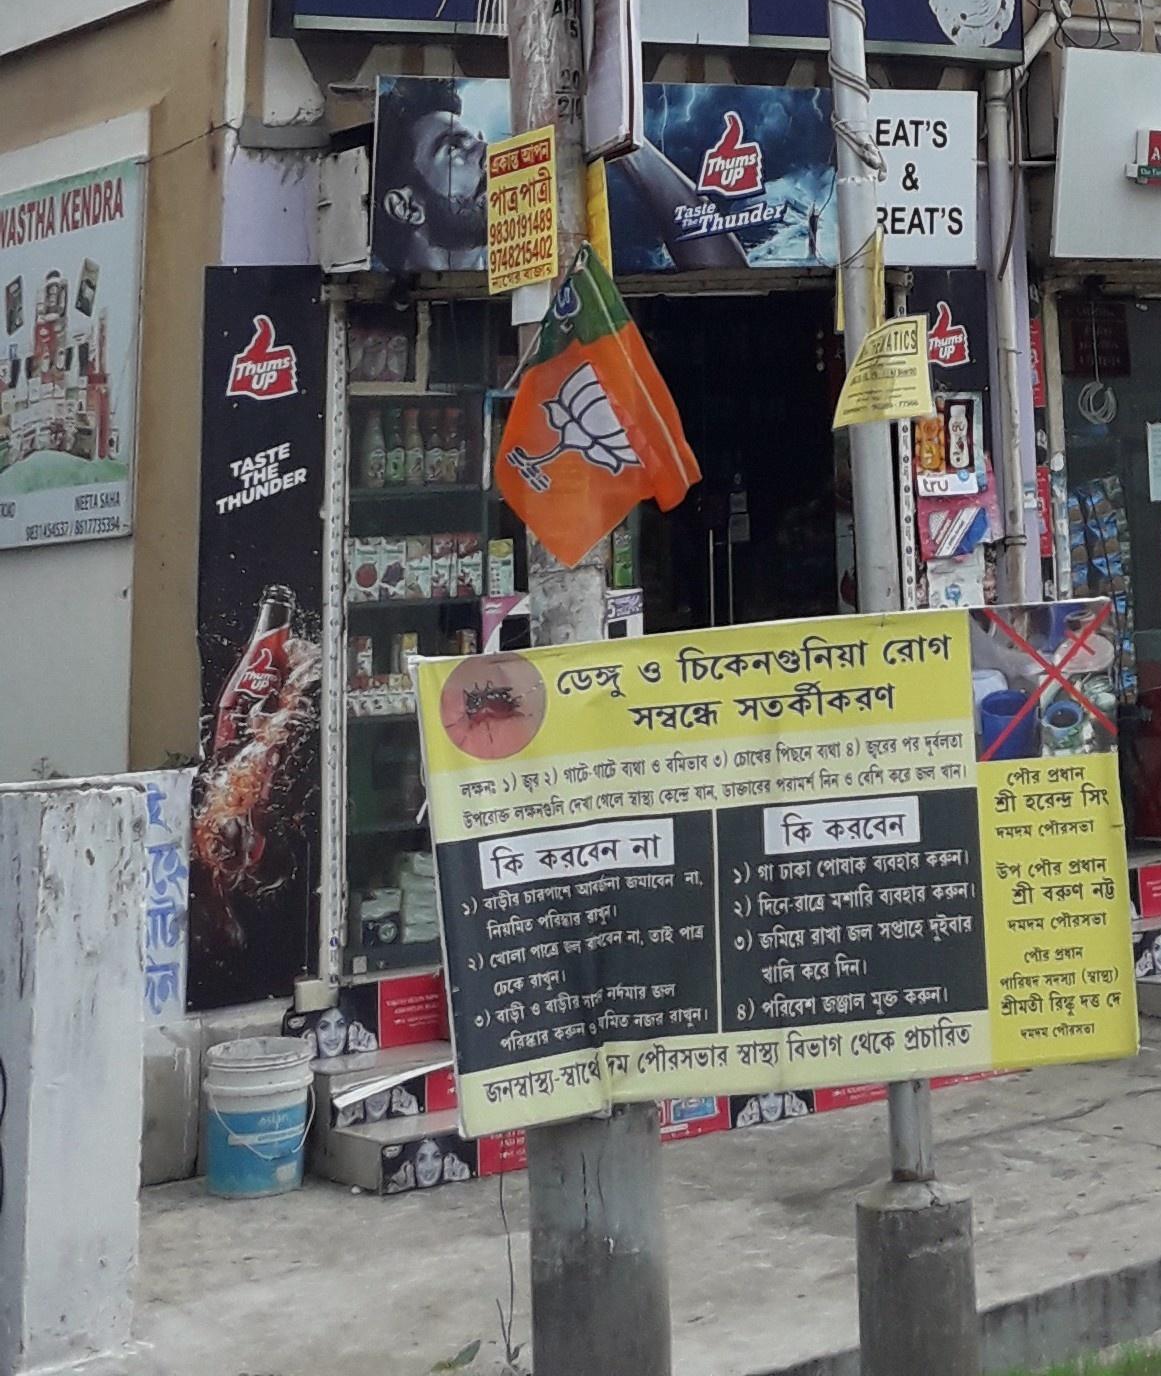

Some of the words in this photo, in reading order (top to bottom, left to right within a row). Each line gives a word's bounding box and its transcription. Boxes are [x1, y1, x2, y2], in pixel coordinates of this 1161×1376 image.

[876, 119, 948, 148] EAT'S
[707, 153, 757, 176] Thums
[720, 167, 744, 187] UP
[902, 162, 919, 191] &
[60, 176, 124, 233] KENDRA
[674, 203, 716, 221] Taste
[699, 203, 785, 233] Thunder
[490, 208, 552, 247] 9830191489
[876, 207, 963, 235] REAT'S
[490, 235, 552, 273] 9748215402
[940, 346, 956, 359] UP
[236, 356, 291, 380] Thums
[251, 371, 278, 390] UP
[230, 442, 291, 478] TASTE
[240, 462, 279, 489] THE
[923, 478, 948, 493] tru
[215, 467, 308, 515] THUNDER
[557, 664, 626, 698] ডেঙ্গু
[638, 661, 662, 683] ও
[883, 633, 952, 666] রোগ
[733, 681, 895, 722] সতর্কীকরণ
[902, 737, 920, 754] পর
[1006, 767, 1041, 787] পৌর
[1048, 767, 1086, 783] প্রধান
[994, 790, 1016, 812] শ্রী
[1023, 790, 1074, 810] হরেন্দ্র
[1080, 782, 1109, 808] সিং
[780, 812, 813, 846] কি
[823, 813, 906, 841] করবেন
[995, 824, 1032, 839] দমদম
[1038, 819, 1094, 837] পৌরসভা
[490, 845, 525, 880] কি
[536, 839, 621, 871] করবেন
[629, 833, 662, 859] না
[996, 862, 1021, 879] উপ
[1027, 858, 1062, 878] পৌর
[1069, 858, 1107, 874] প্রধান
[757, 864, 775, 881] গা
[779, 860, 811, 878] ঢাকা
[832, 884, 873, 911] মশারি
[1012, 881, 1035, 905] শ্রী
[1041, 882, 1083, 902] বরুণ
[810, 927, 841, 945] রাখা
[846, 924, 873, 942] জল
[1008, 918, 1044, 931] দমদম
[1051, 911, 1107, 930] পৌরসভা
[1024, 947, 1049, 963] পৌর
[1055, 947, 1084, 960] প্রধান
[761, 958, 794, 985] খালি
[801, 961, 829, 981] করে
[762, 992, 816, 1019] পরিবেশ
[1001, 993, 1043, 1016] শ্রীমতী
[1079, 993, 1100, 1008] দত্ত
[1106, 991, 1121, 1008] দে
[634, 1010, 664, 1028] নজর
[638, 1043, 729, 1074] পৌরসভার
[786, 1030, 842, 1062] বিভাগ
[851, 1031, 896, 1056] থেকে
[904, 1016, 972, 1050] প্রচারিত
